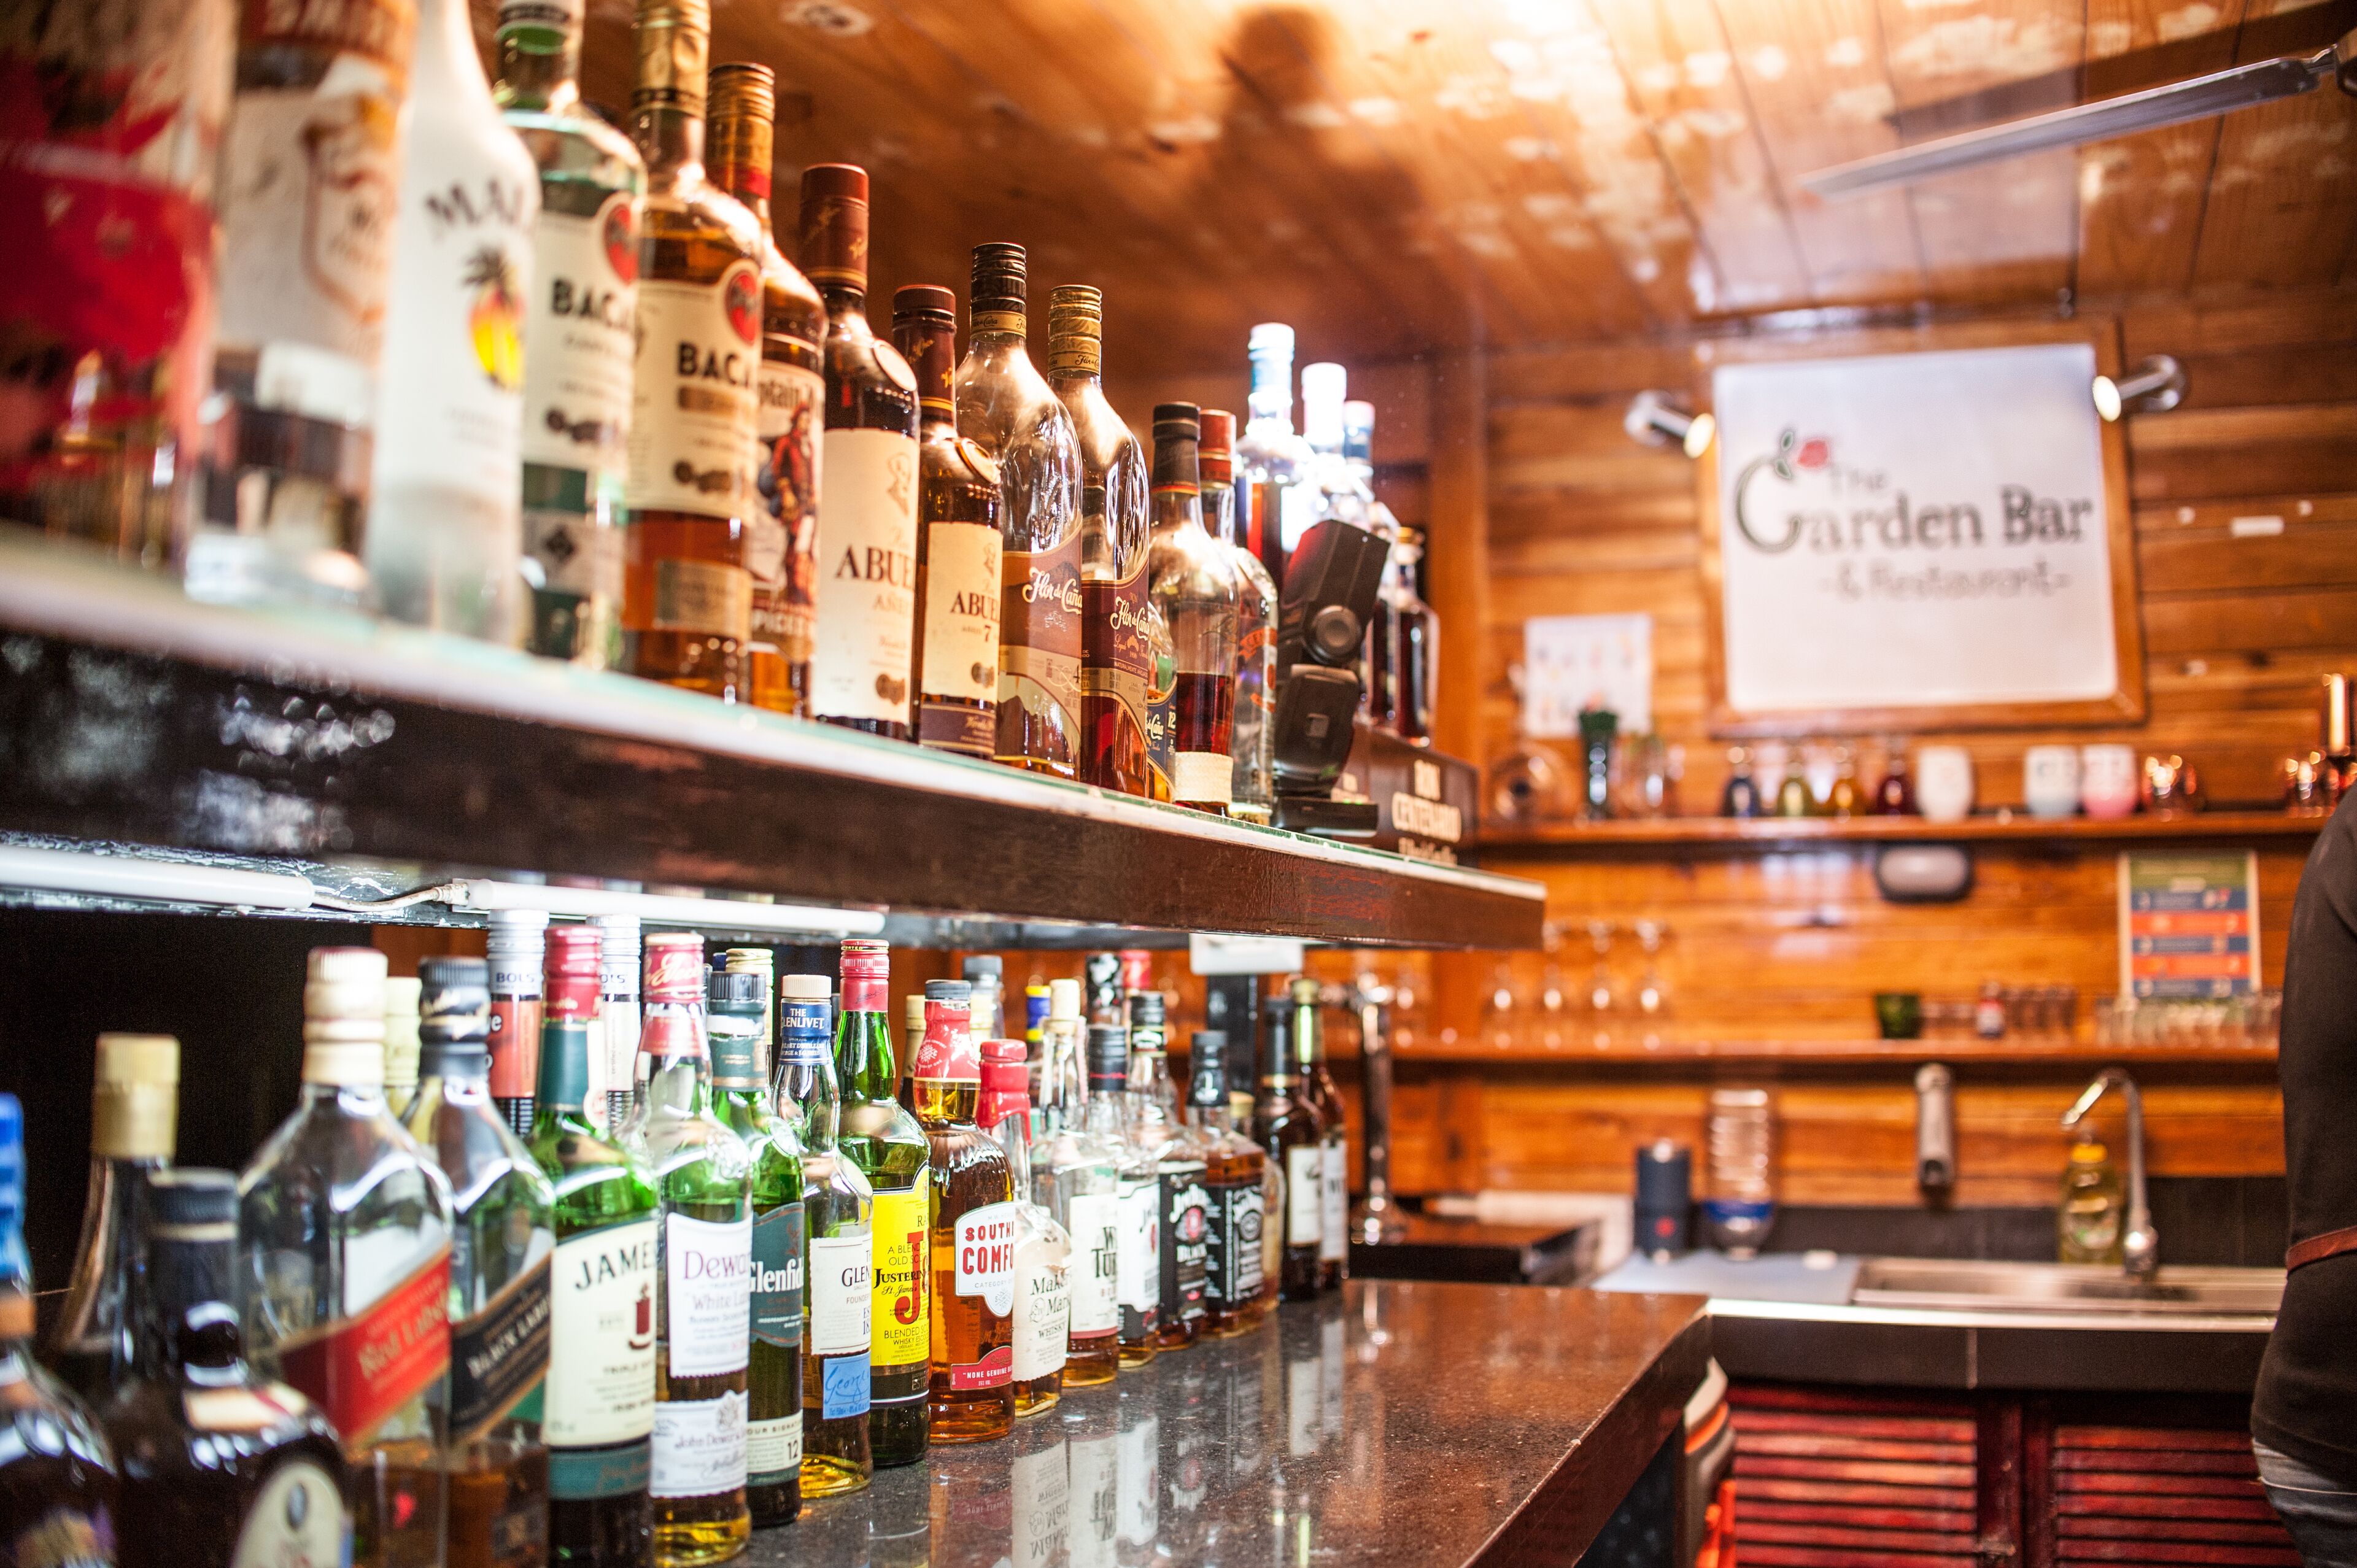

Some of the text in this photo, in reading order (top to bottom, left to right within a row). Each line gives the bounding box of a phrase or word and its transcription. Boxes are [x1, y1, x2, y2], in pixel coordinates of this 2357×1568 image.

[1736, 455, 2092, 555] Garden Bar
[1022, 566, 1055, 603] Flor
[1061, 578, 1083, 615] Caña
[1110, 596, 1132, 630] Flor
[1136, 607, 1150, 641] Caña
[984, 625, 991, 642] 7
[1168, 711, 1176, 729] 12
[790, 1008, 807, 1017] THE
[898, 1243, 920, 1253] BLEND
[575, 1241, 656, 1290] JAME
[889, 1256, 908, 1265] OLD
[962, 1243, 1014, 1275] COMFO
[842, 1265, 872, 1288] GLEN
[884, 1326, 919, 1339] BLENDED
[986, 1367, 1007, 1377] GENUINE
[788, 1439, 798, 1460] 12
